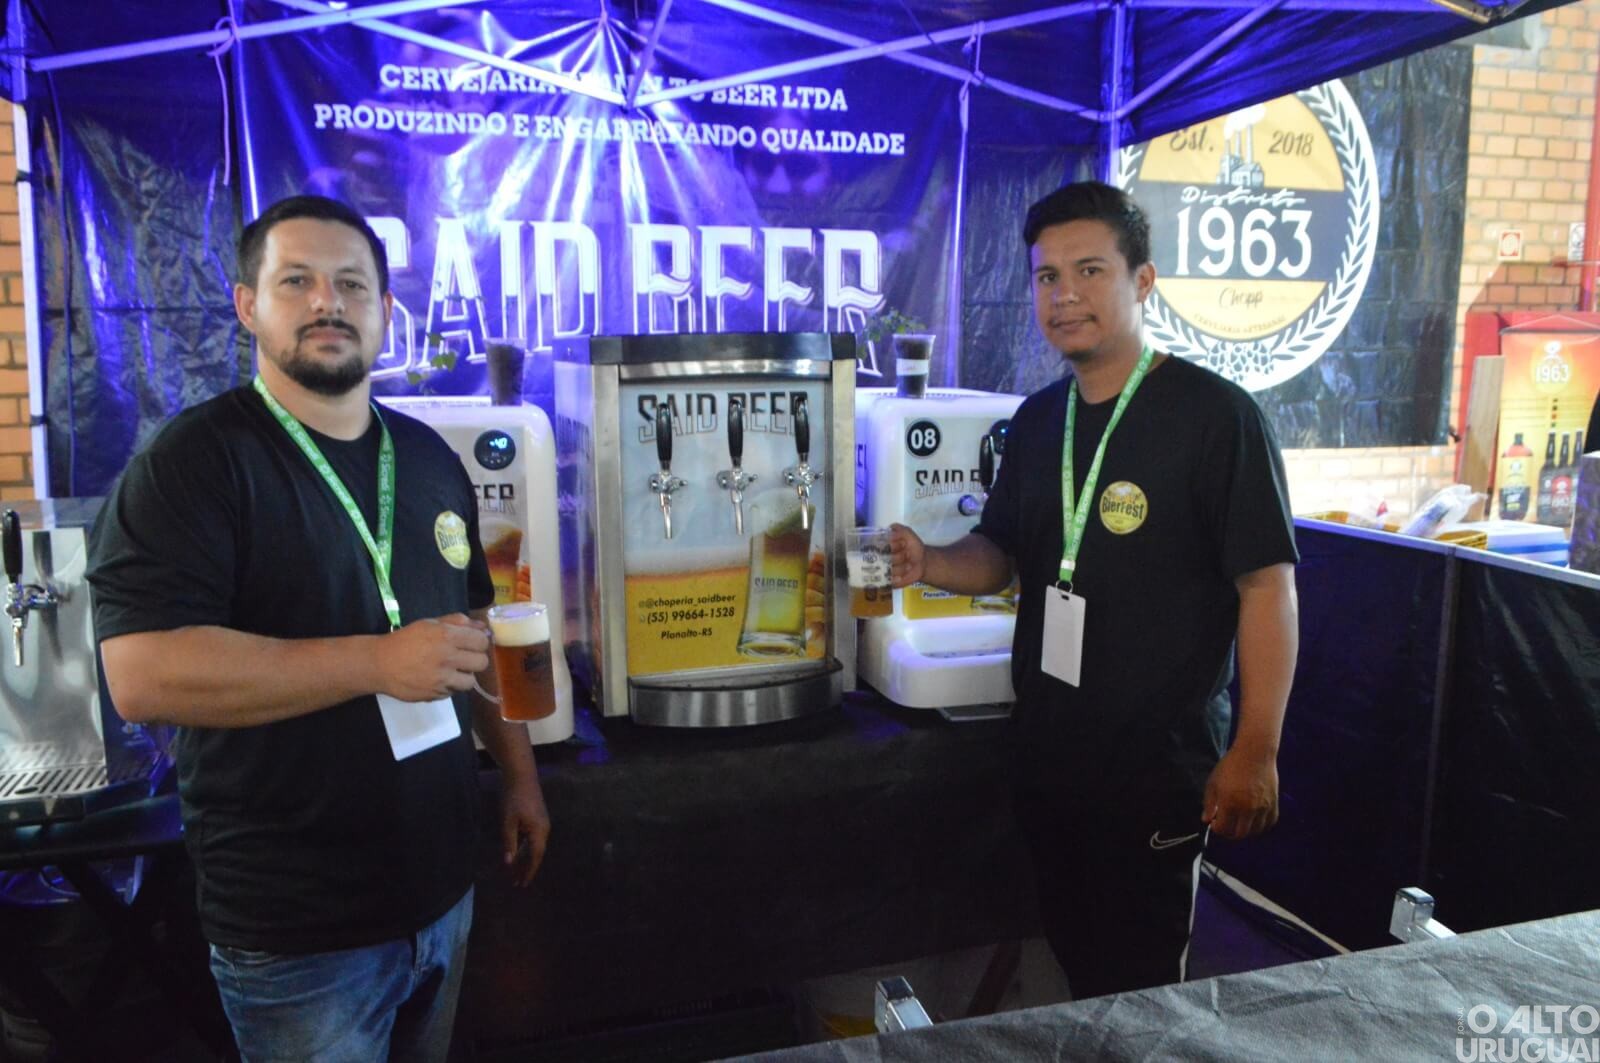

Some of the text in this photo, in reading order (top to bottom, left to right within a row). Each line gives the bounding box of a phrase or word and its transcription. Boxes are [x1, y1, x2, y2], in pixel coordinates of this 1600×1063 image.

[782, 85, 848, 111] LTDA
[314, 103, 508, 135] PRODUZINDO
[512, 113, 529, 137] E
[761, 126, 905, 155] QUALIDADE
[1268, 130, 1314, 157] 2018
[1176, 205, 1313, 278] 1963
[1535, 363, 1570, 384] 1963
[910, 428, 937, 450] 08
[915, 469, 964, 499] SAID
[472, 483, 516, 514] EER
[647, 606, 735, 625] (55) 99664-1528
[661, 627, 713, 640] Planalto-RS
